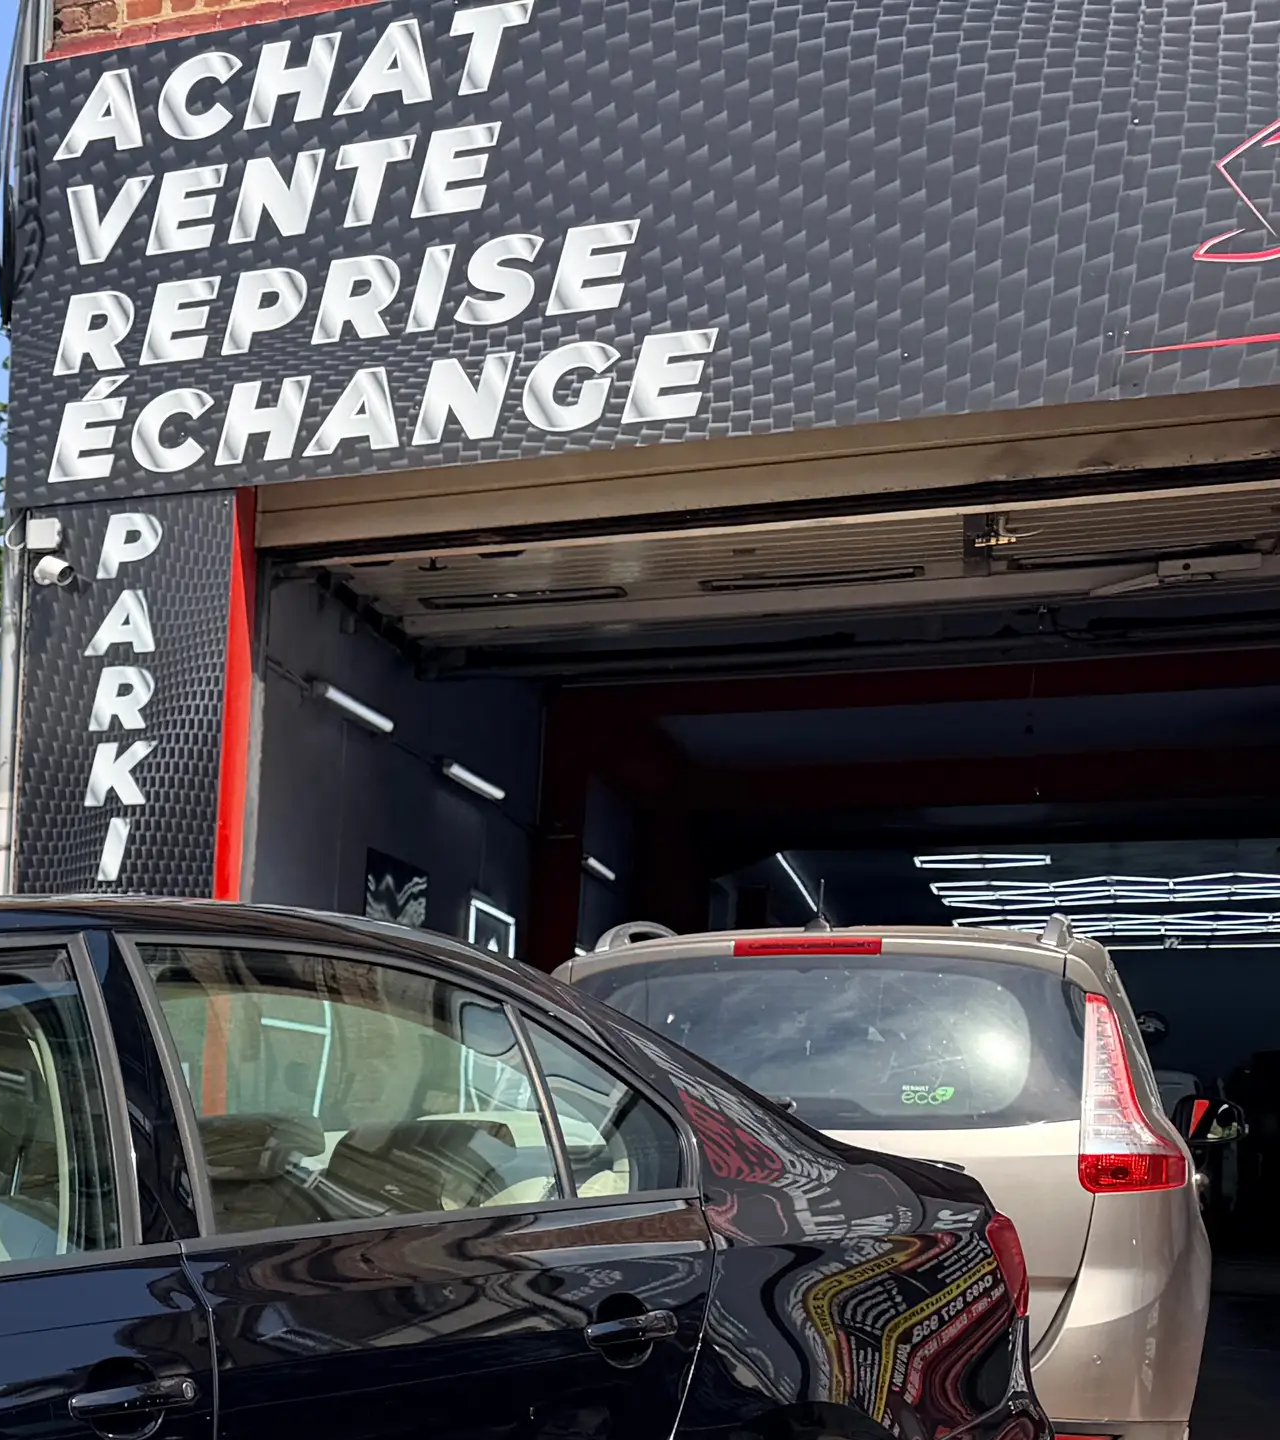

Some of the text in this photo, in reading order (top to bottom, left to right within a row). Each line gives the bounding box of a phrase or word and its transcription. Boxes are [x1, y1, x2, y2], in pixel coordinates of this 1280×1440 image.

[53, 1, 536, 161] ACHAT
[66, 121, 503, 266] VENTE
[52, 218, 641, 377] REPRISE
[47, 327, 720, 484] ÉCHANGE
